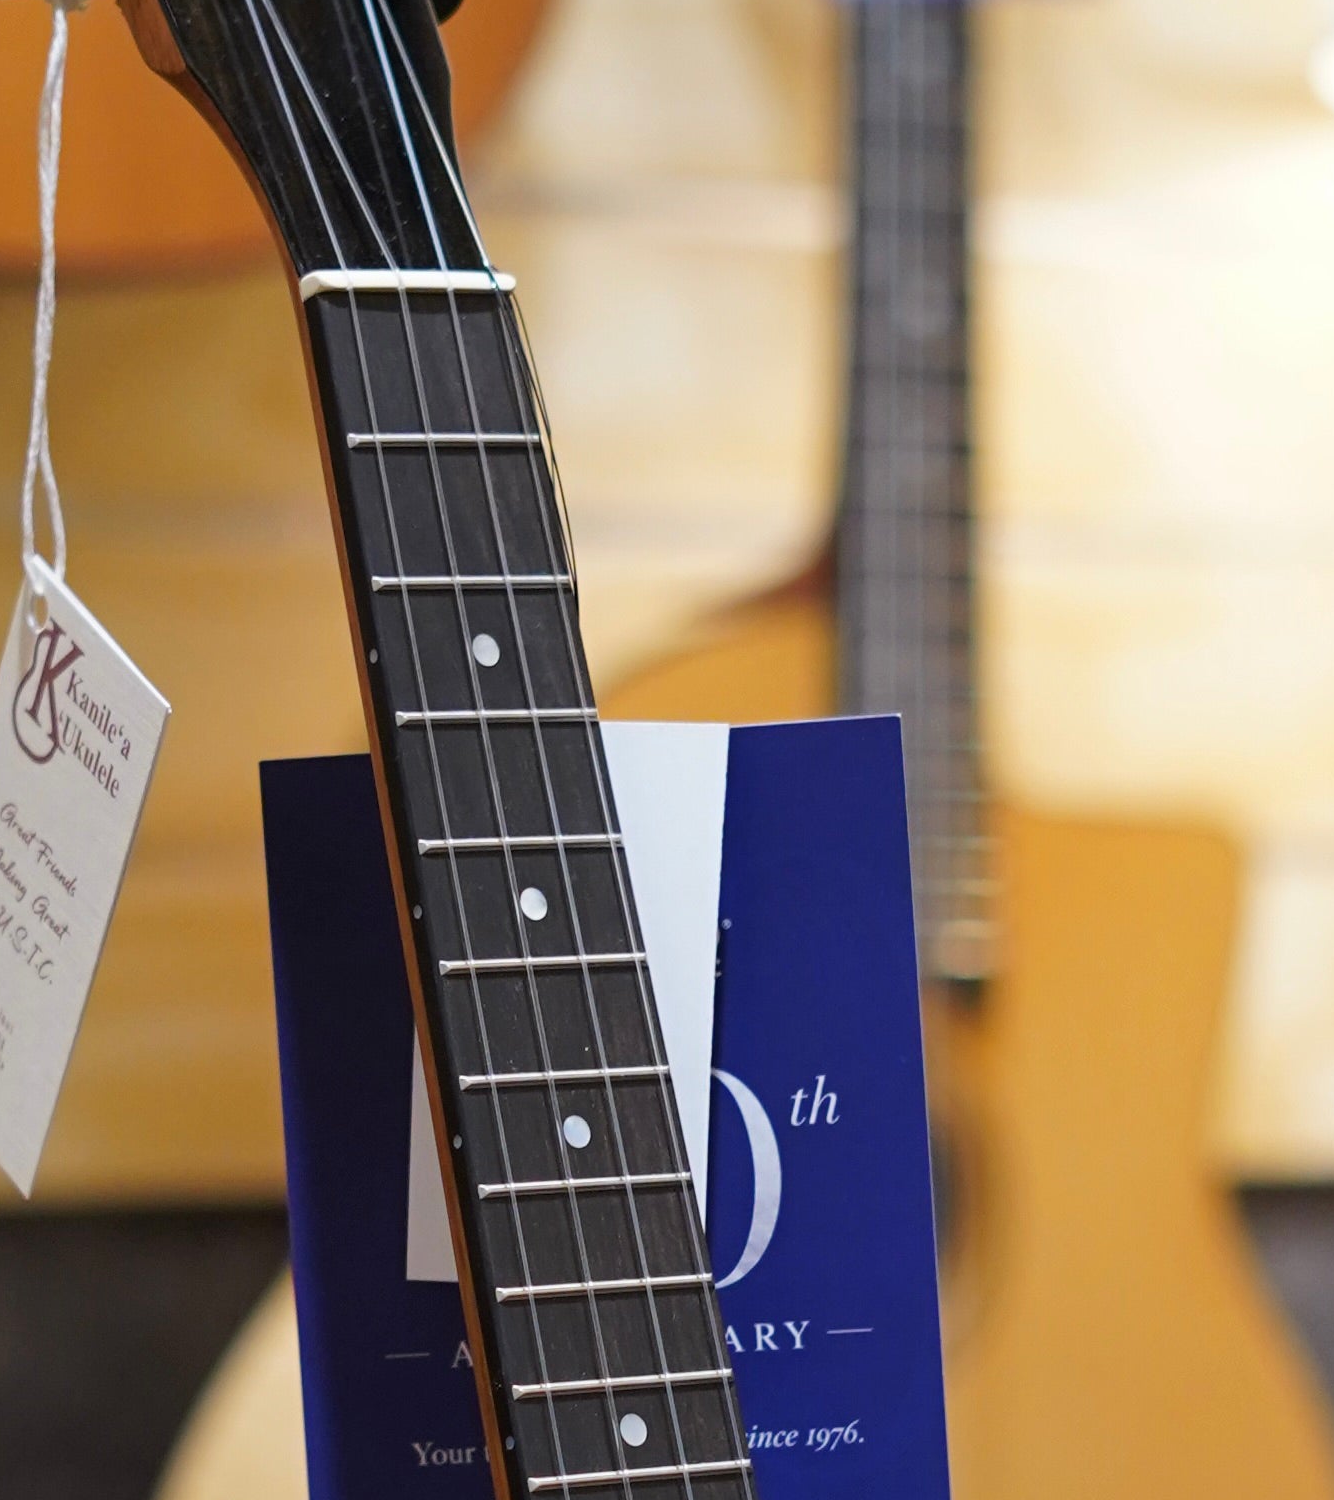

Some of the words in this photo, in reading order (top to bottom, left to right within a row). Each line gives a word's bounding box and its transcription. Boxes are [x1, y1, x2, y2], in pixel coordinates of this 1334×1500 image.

[0, 803, 36, 850] Great
[37, 839, 78, 897] Friends
[31, 895, 71, 941] Great
[412, 1441, 476, 1467] Your
[746, 1424, 799, 1449] ince
[805, 1419, 865, 1452] 1976.
